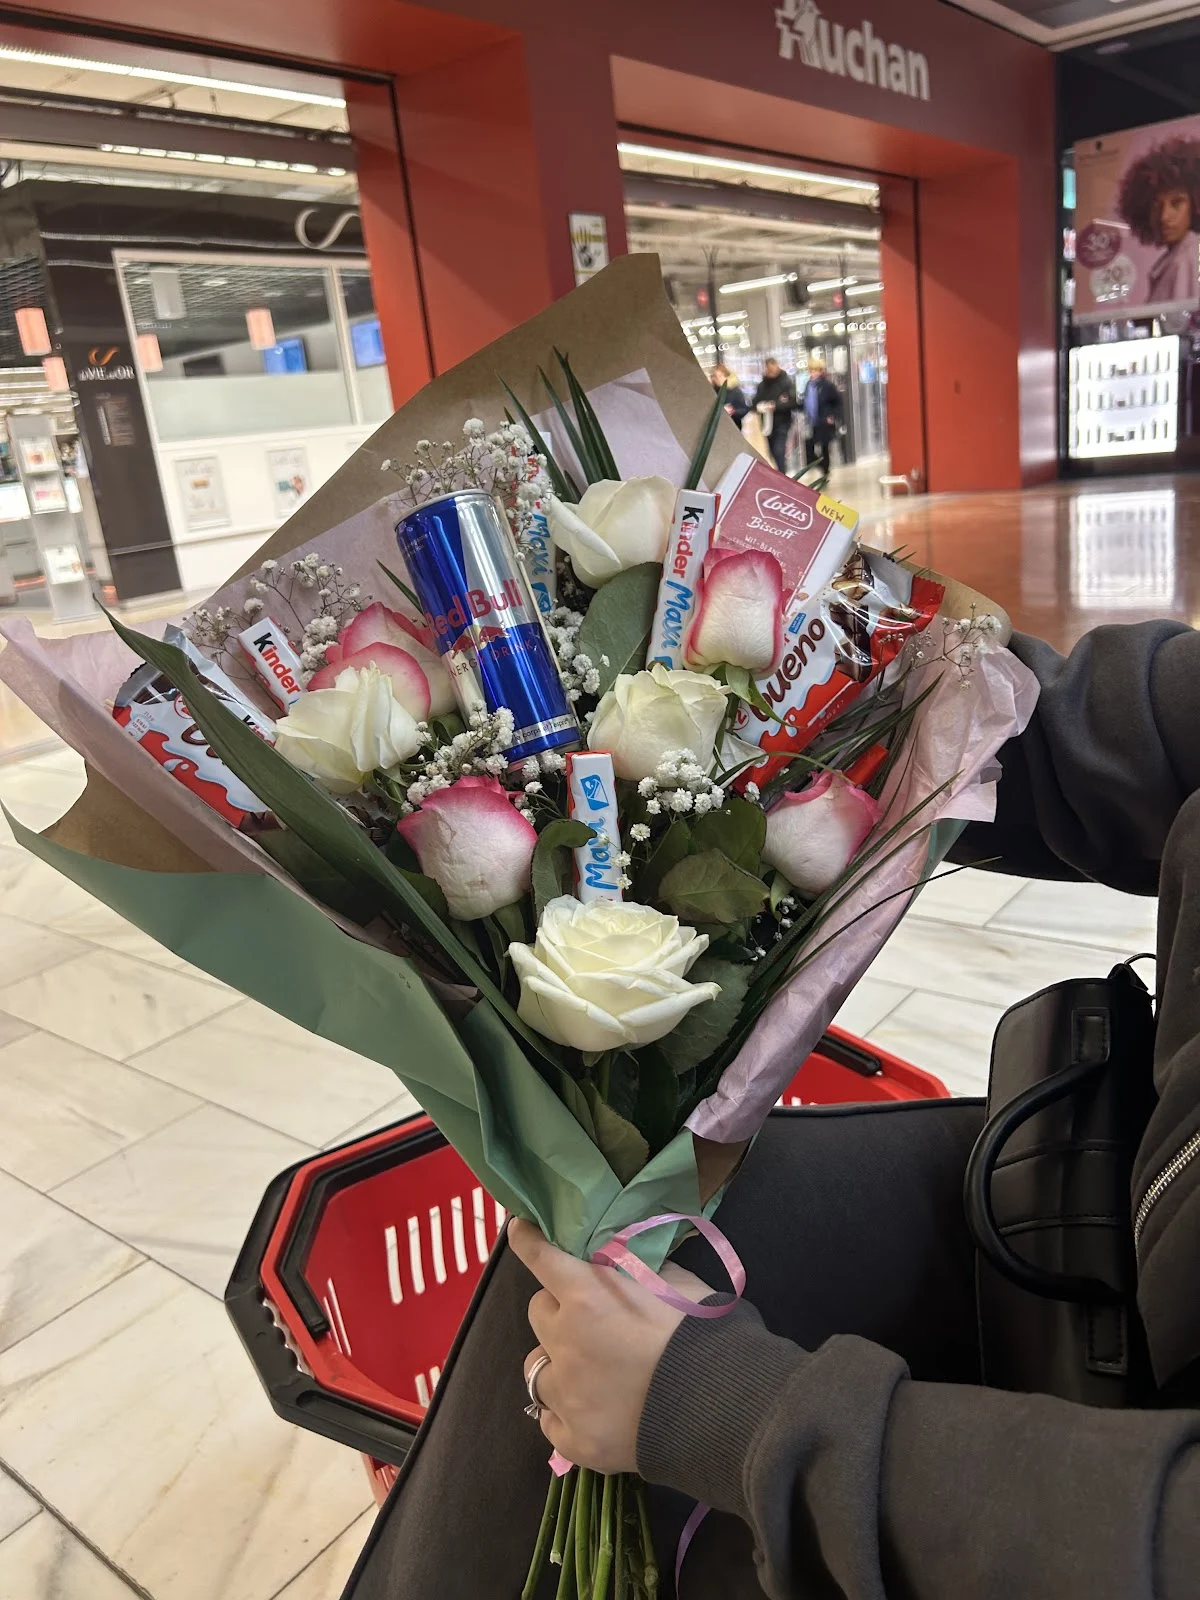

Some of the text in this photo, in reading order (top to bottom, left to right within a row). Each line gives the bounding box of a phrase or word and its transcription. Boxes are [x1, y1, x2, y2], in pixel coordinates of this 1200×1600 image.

[775, 0, 931, 100] Auchan
[746, 516, 800, 540] Biscoff
[762, 495, 808, 523] Lotus
[821, 505, 845, 523] NEW
[528, 513, 553, 576] Maxi
[661, 506, 705, 649] Kinder Maxi
[424, 578, 523, 638] Red Bull
[252, 631, 302, 695] Kinder
[492, 640, 532, 660] DRNK
